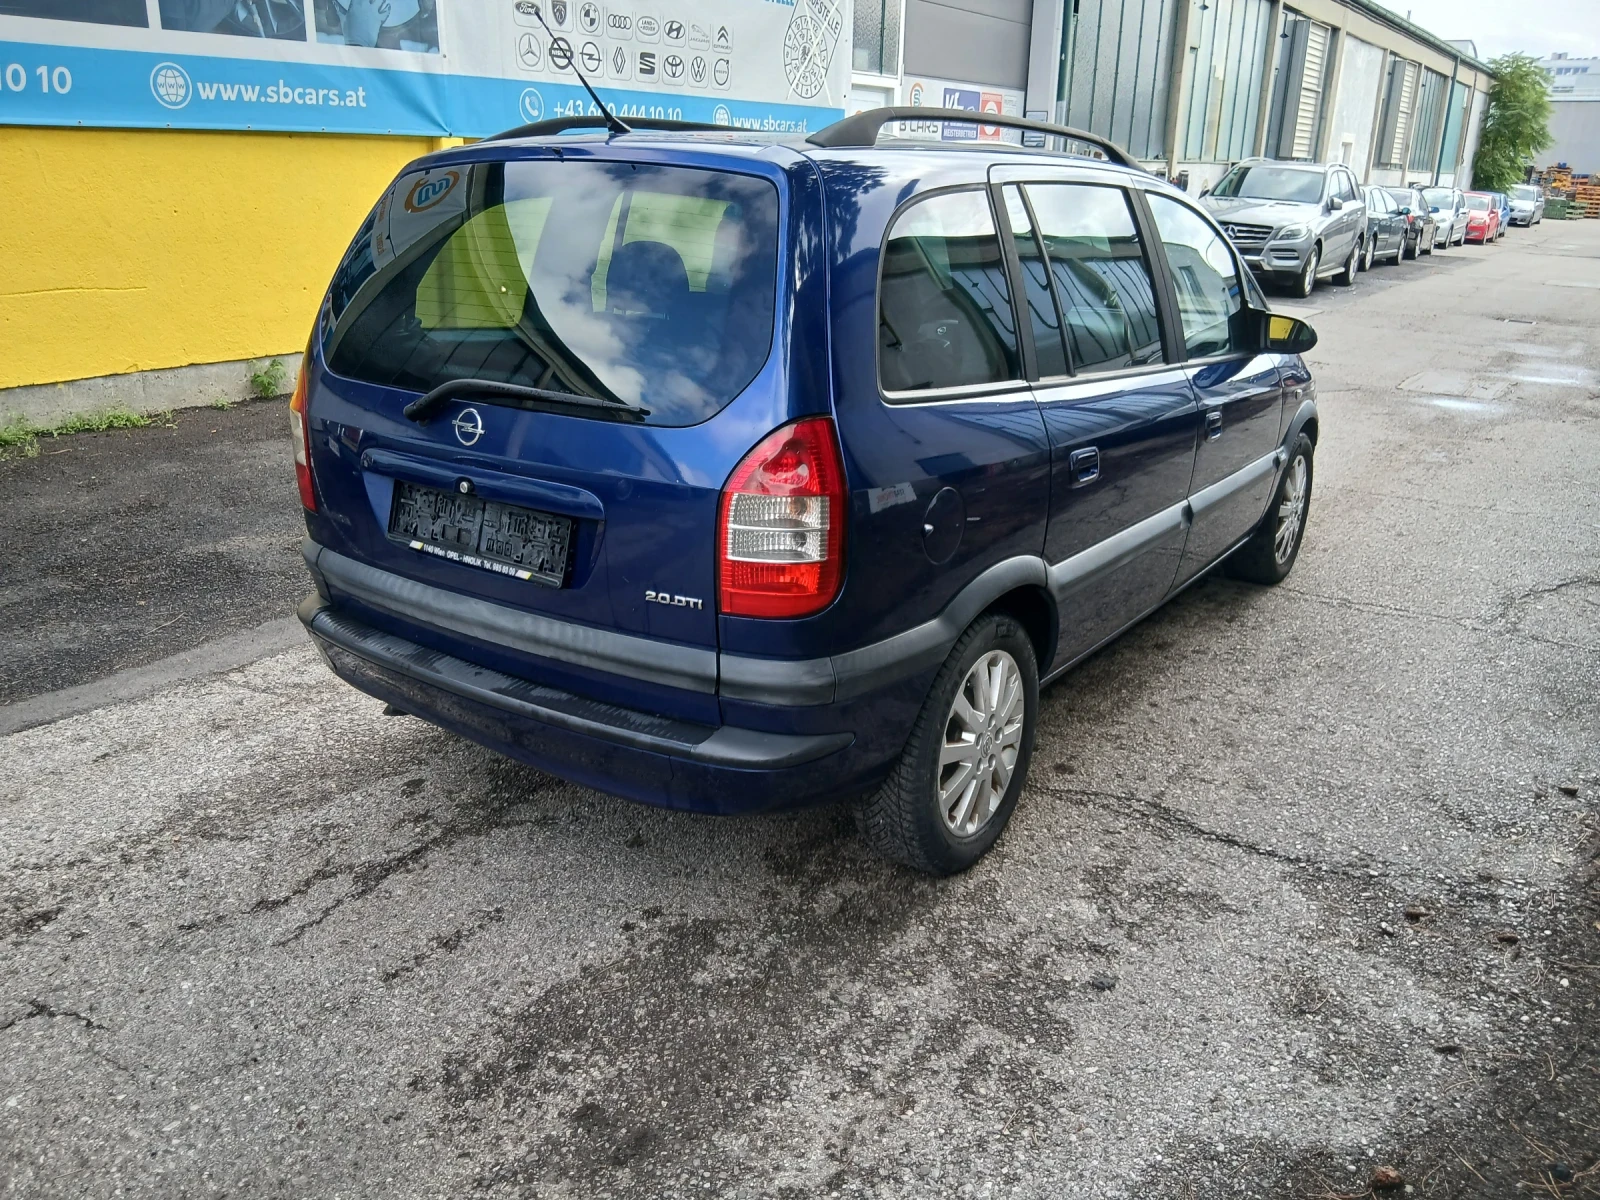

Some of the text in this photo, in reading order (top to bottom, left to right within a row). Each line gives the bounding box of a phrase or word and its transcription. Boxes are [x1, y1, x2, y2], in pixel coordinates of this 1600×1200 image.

[519, 3, 537, 14] Ford
[0, 63, 73, 95] 0 10
[197, 79, 367, 108] www.sbcars.at
[553, 100, 584, 118] +43
[620, 104, 646, 119] 444
[649, 106, 664, 120] 10
[667, 108, 682, 121] 10
[732, 114, 807, 133] www.sbcars.at
[446, 550, 459, 561] OPEL
